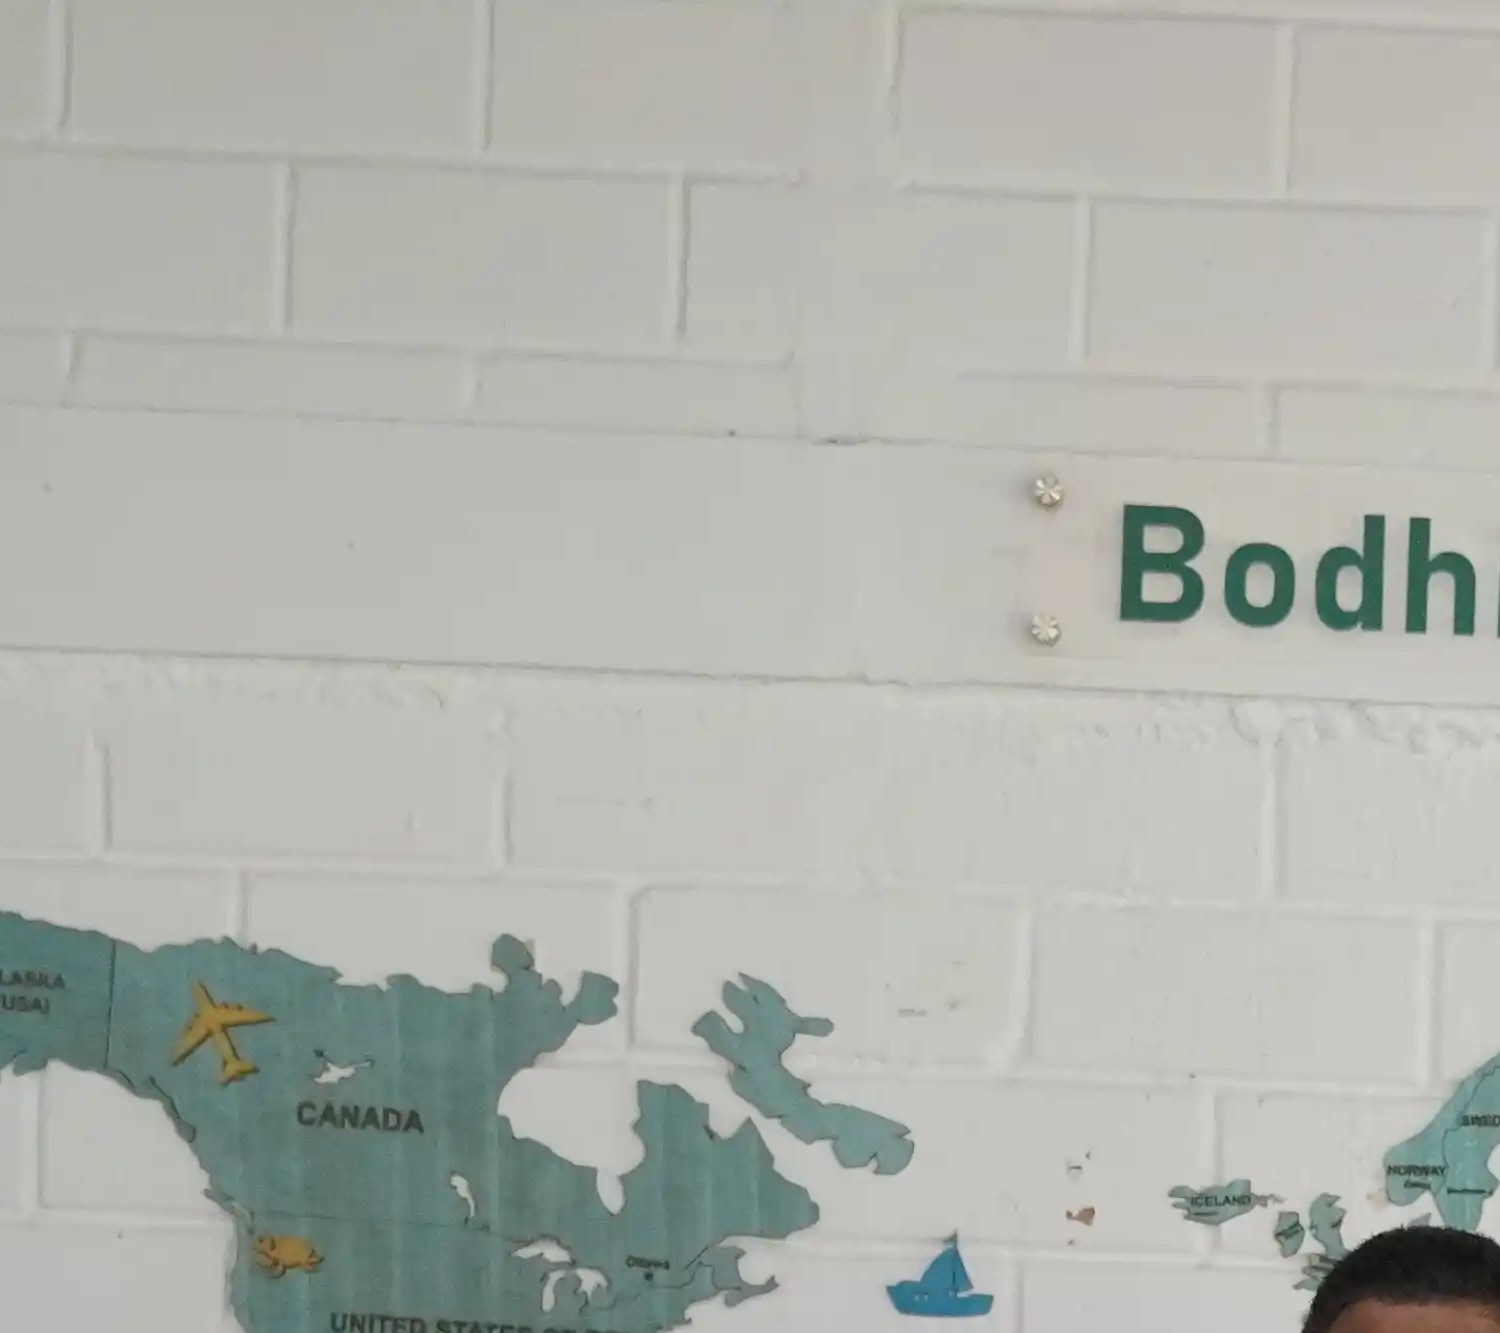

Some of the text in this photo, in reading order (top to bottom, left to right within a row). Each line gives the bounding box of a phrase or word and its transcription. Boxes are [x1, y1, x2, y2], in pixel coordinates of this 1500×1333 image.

[296, 1102, 424, 1134] CANADA
[1387, 1164, 1448, 1179] NORWAY
[1190, 1194, 1252, 1208] ICELAND
